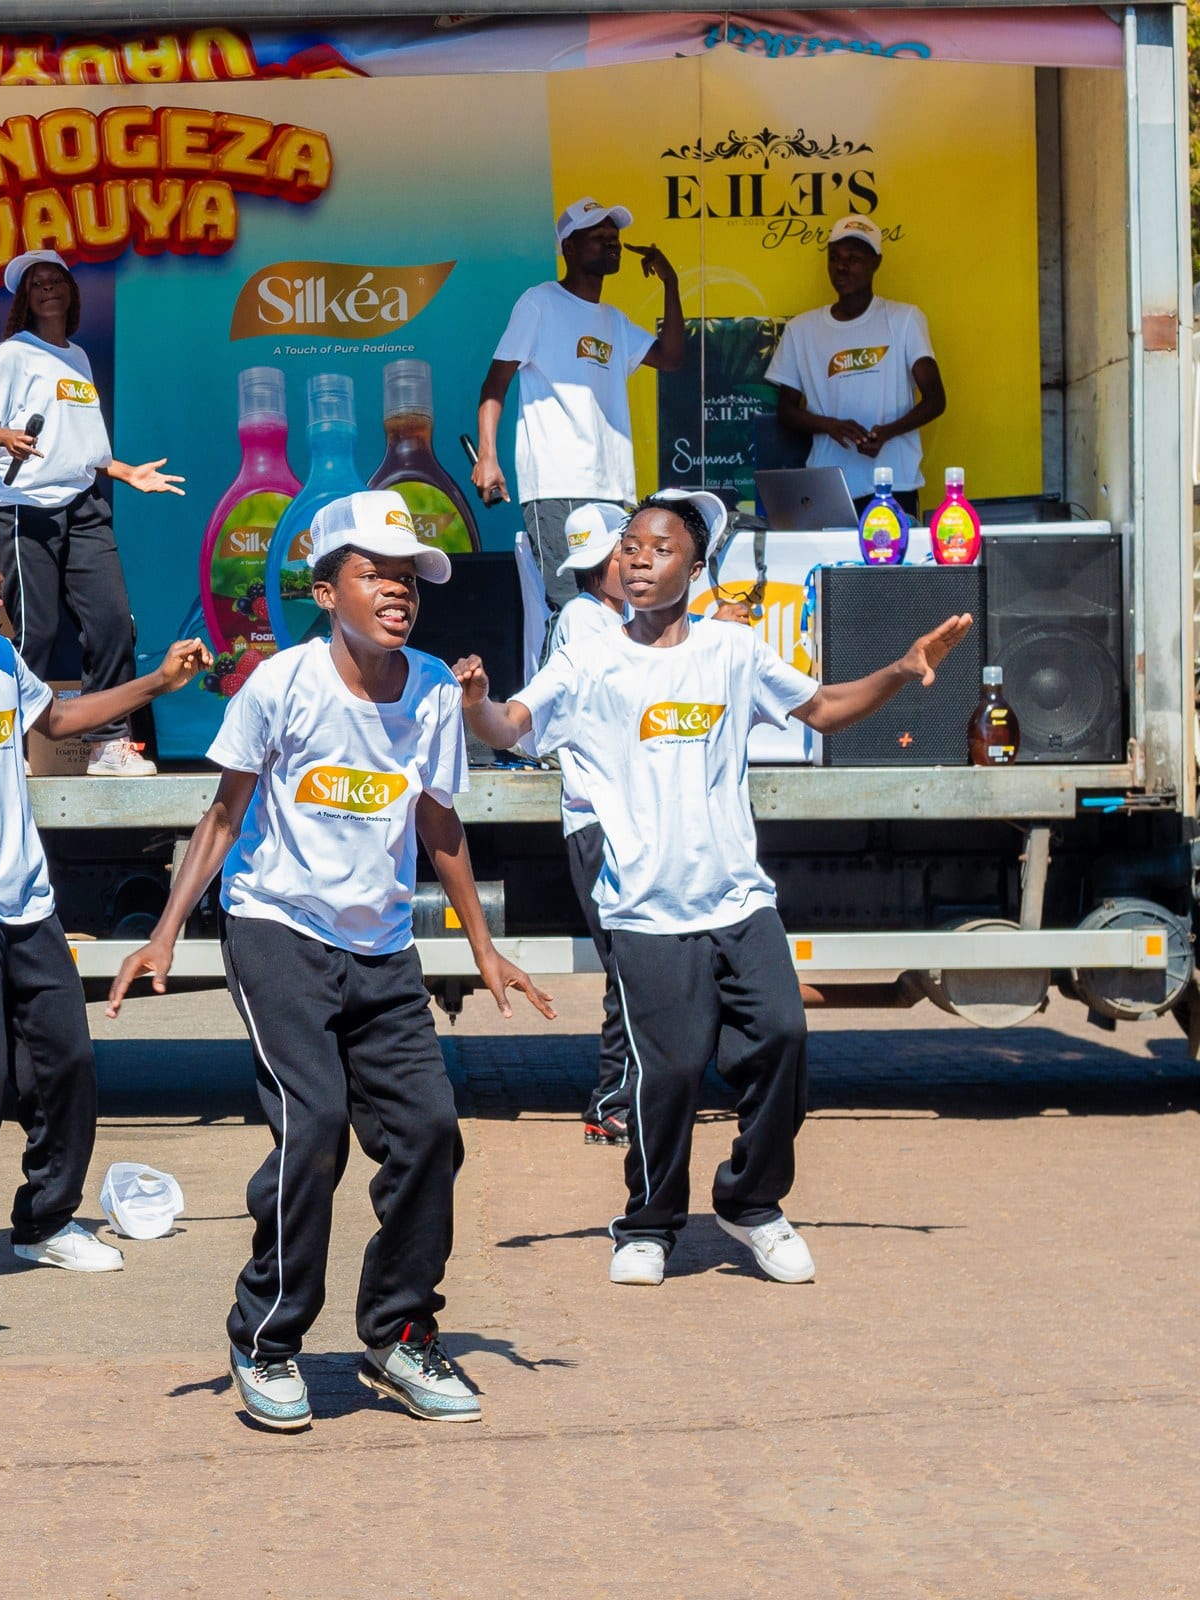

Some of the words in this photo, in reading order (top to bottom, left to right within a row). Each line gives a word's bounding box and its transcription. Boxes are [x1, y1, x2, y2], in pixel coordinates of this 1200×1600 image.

[257, 271, 409, 325] Silkéa
[273, 346, 282, 355] A
[285, 345, 318, 355] Touch
[320, 345, 331, 354] of
[334, 344, 360, 354] Pure
[362, 342, 415, 353] Radiance
[833, 348, 879, 371] Silkéa
[672, 438, 745, 474] Summer
[648, 704, 712, 733] Silkéa
[310, 772, 390, 805] Silkéa
[323, 812, 342, 820] Touch
